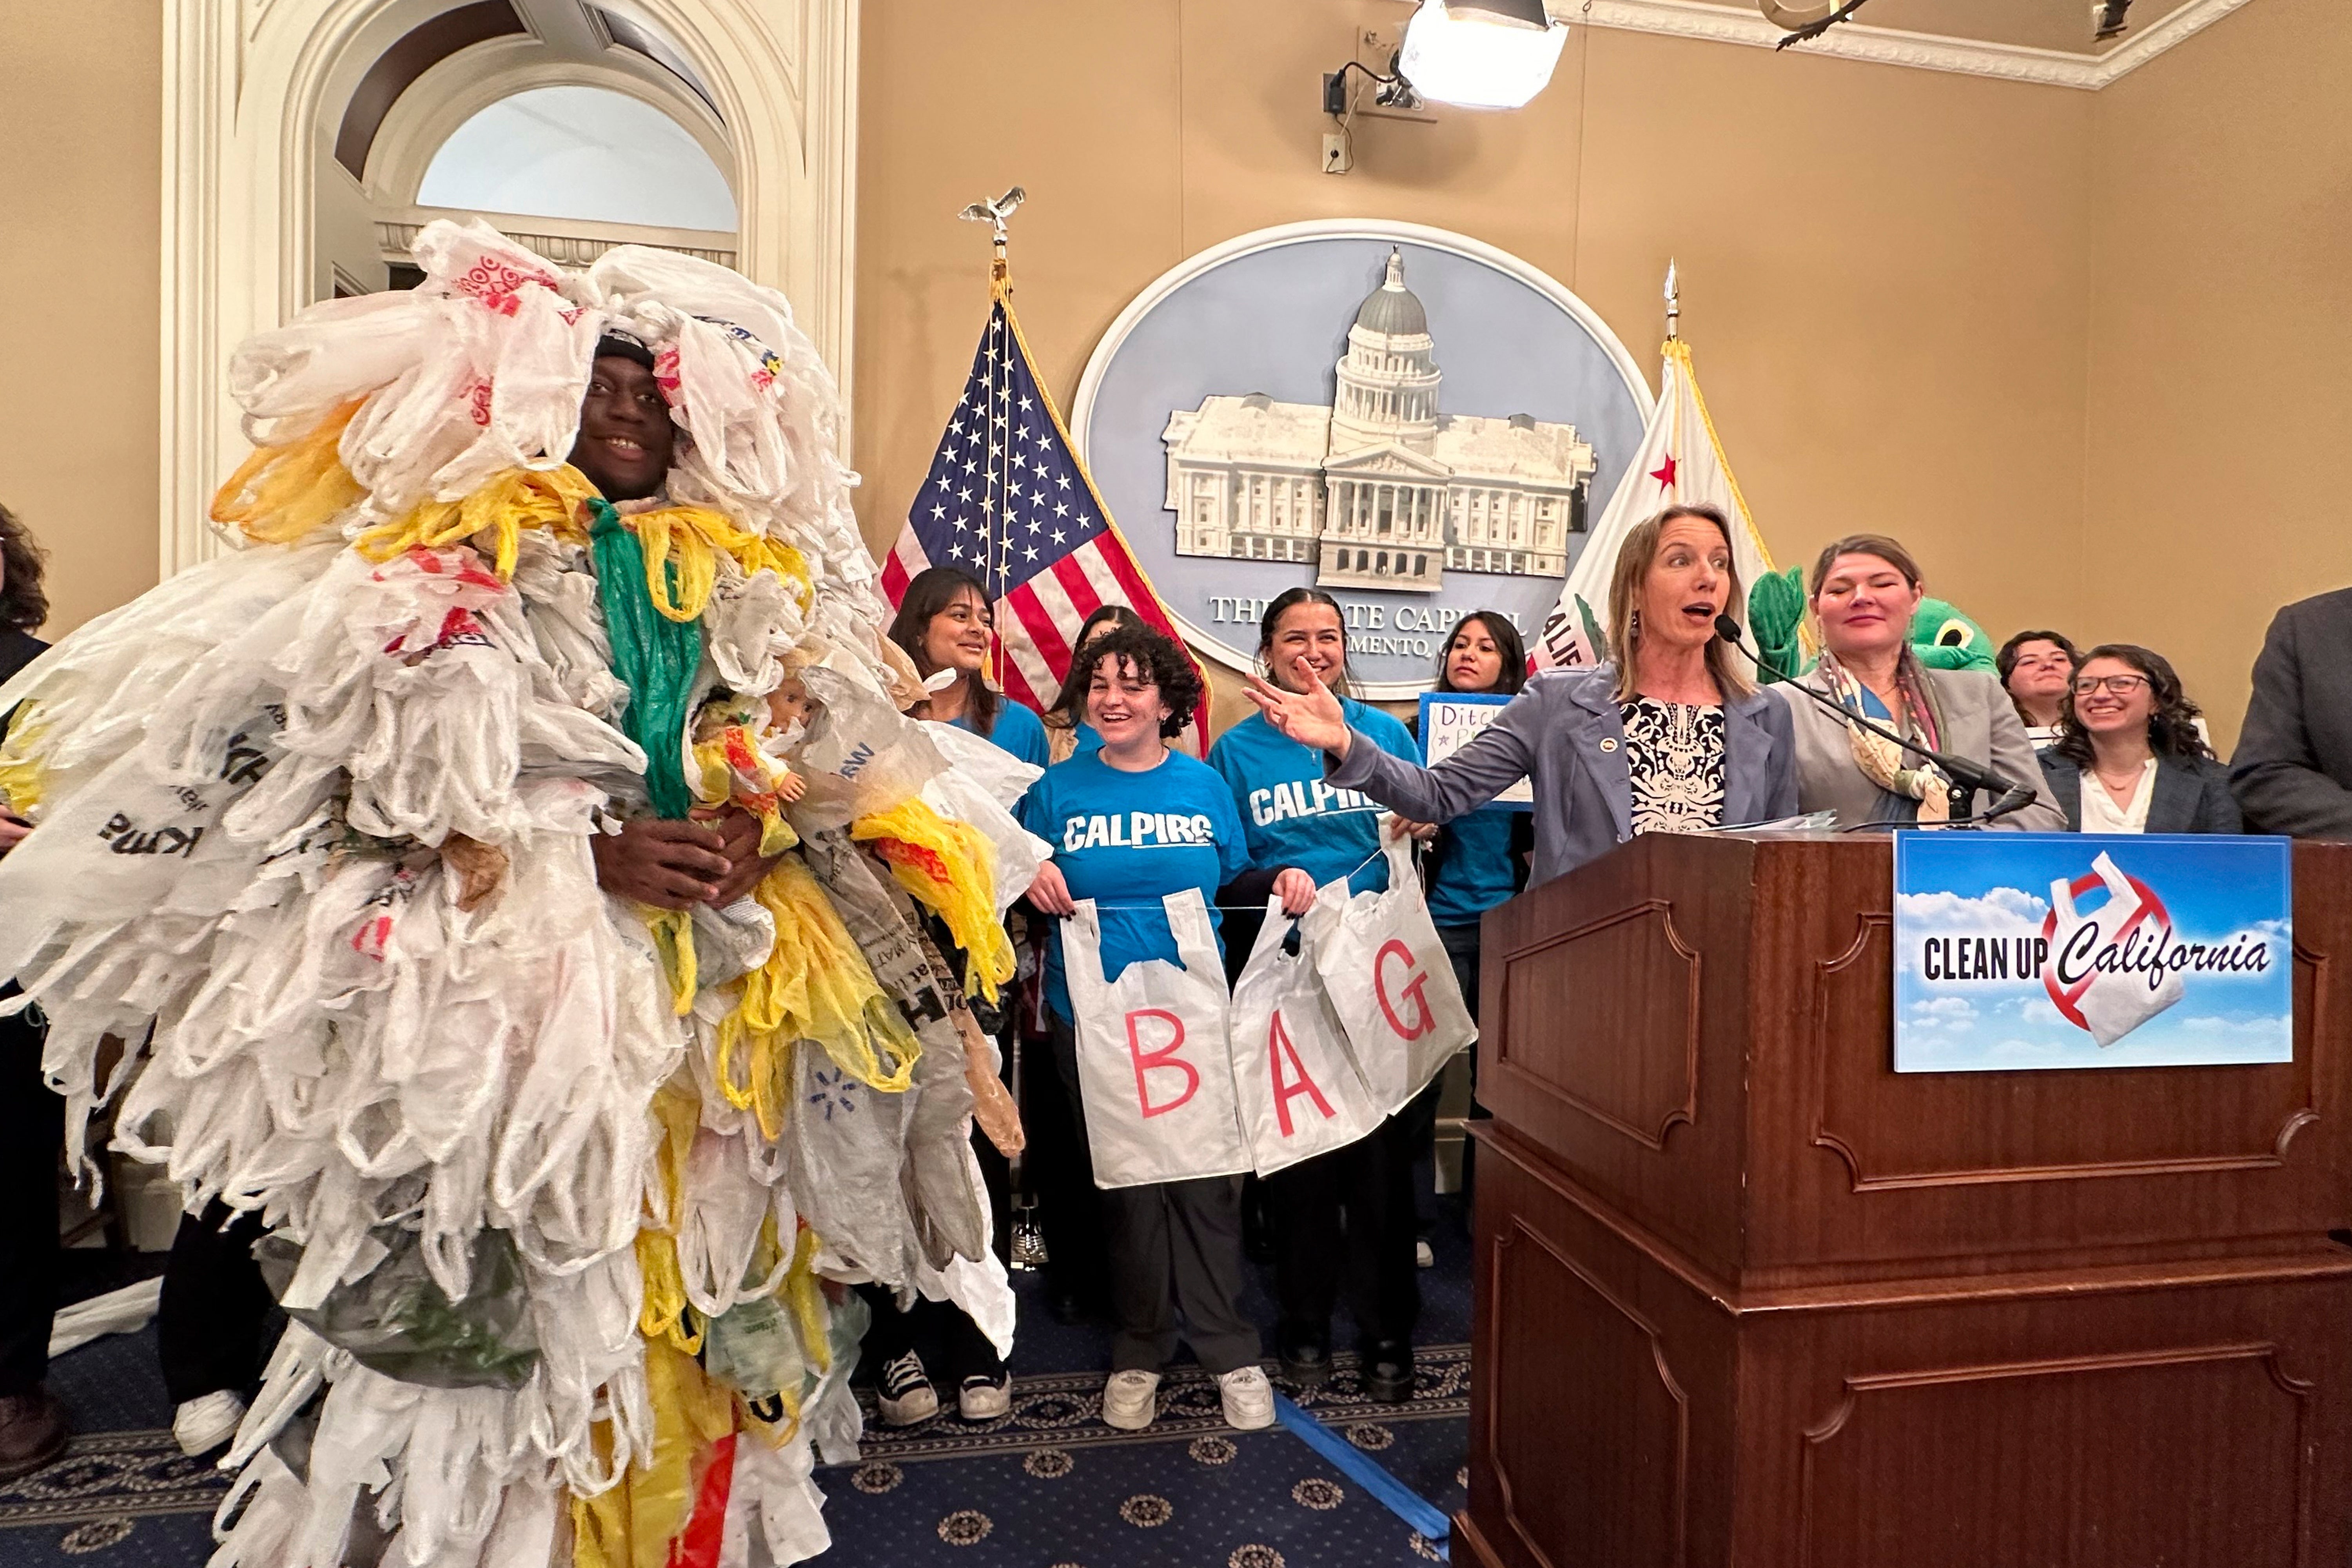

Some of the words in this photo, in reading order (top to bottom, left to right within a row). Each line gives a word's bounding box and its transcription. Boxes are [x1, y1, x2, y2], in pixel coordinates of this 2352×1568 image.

[1924, 938, 2008, 980] CLEAN
[2017, 938, 2048, 979] UP
[2058, 921, 2271, 991] California
